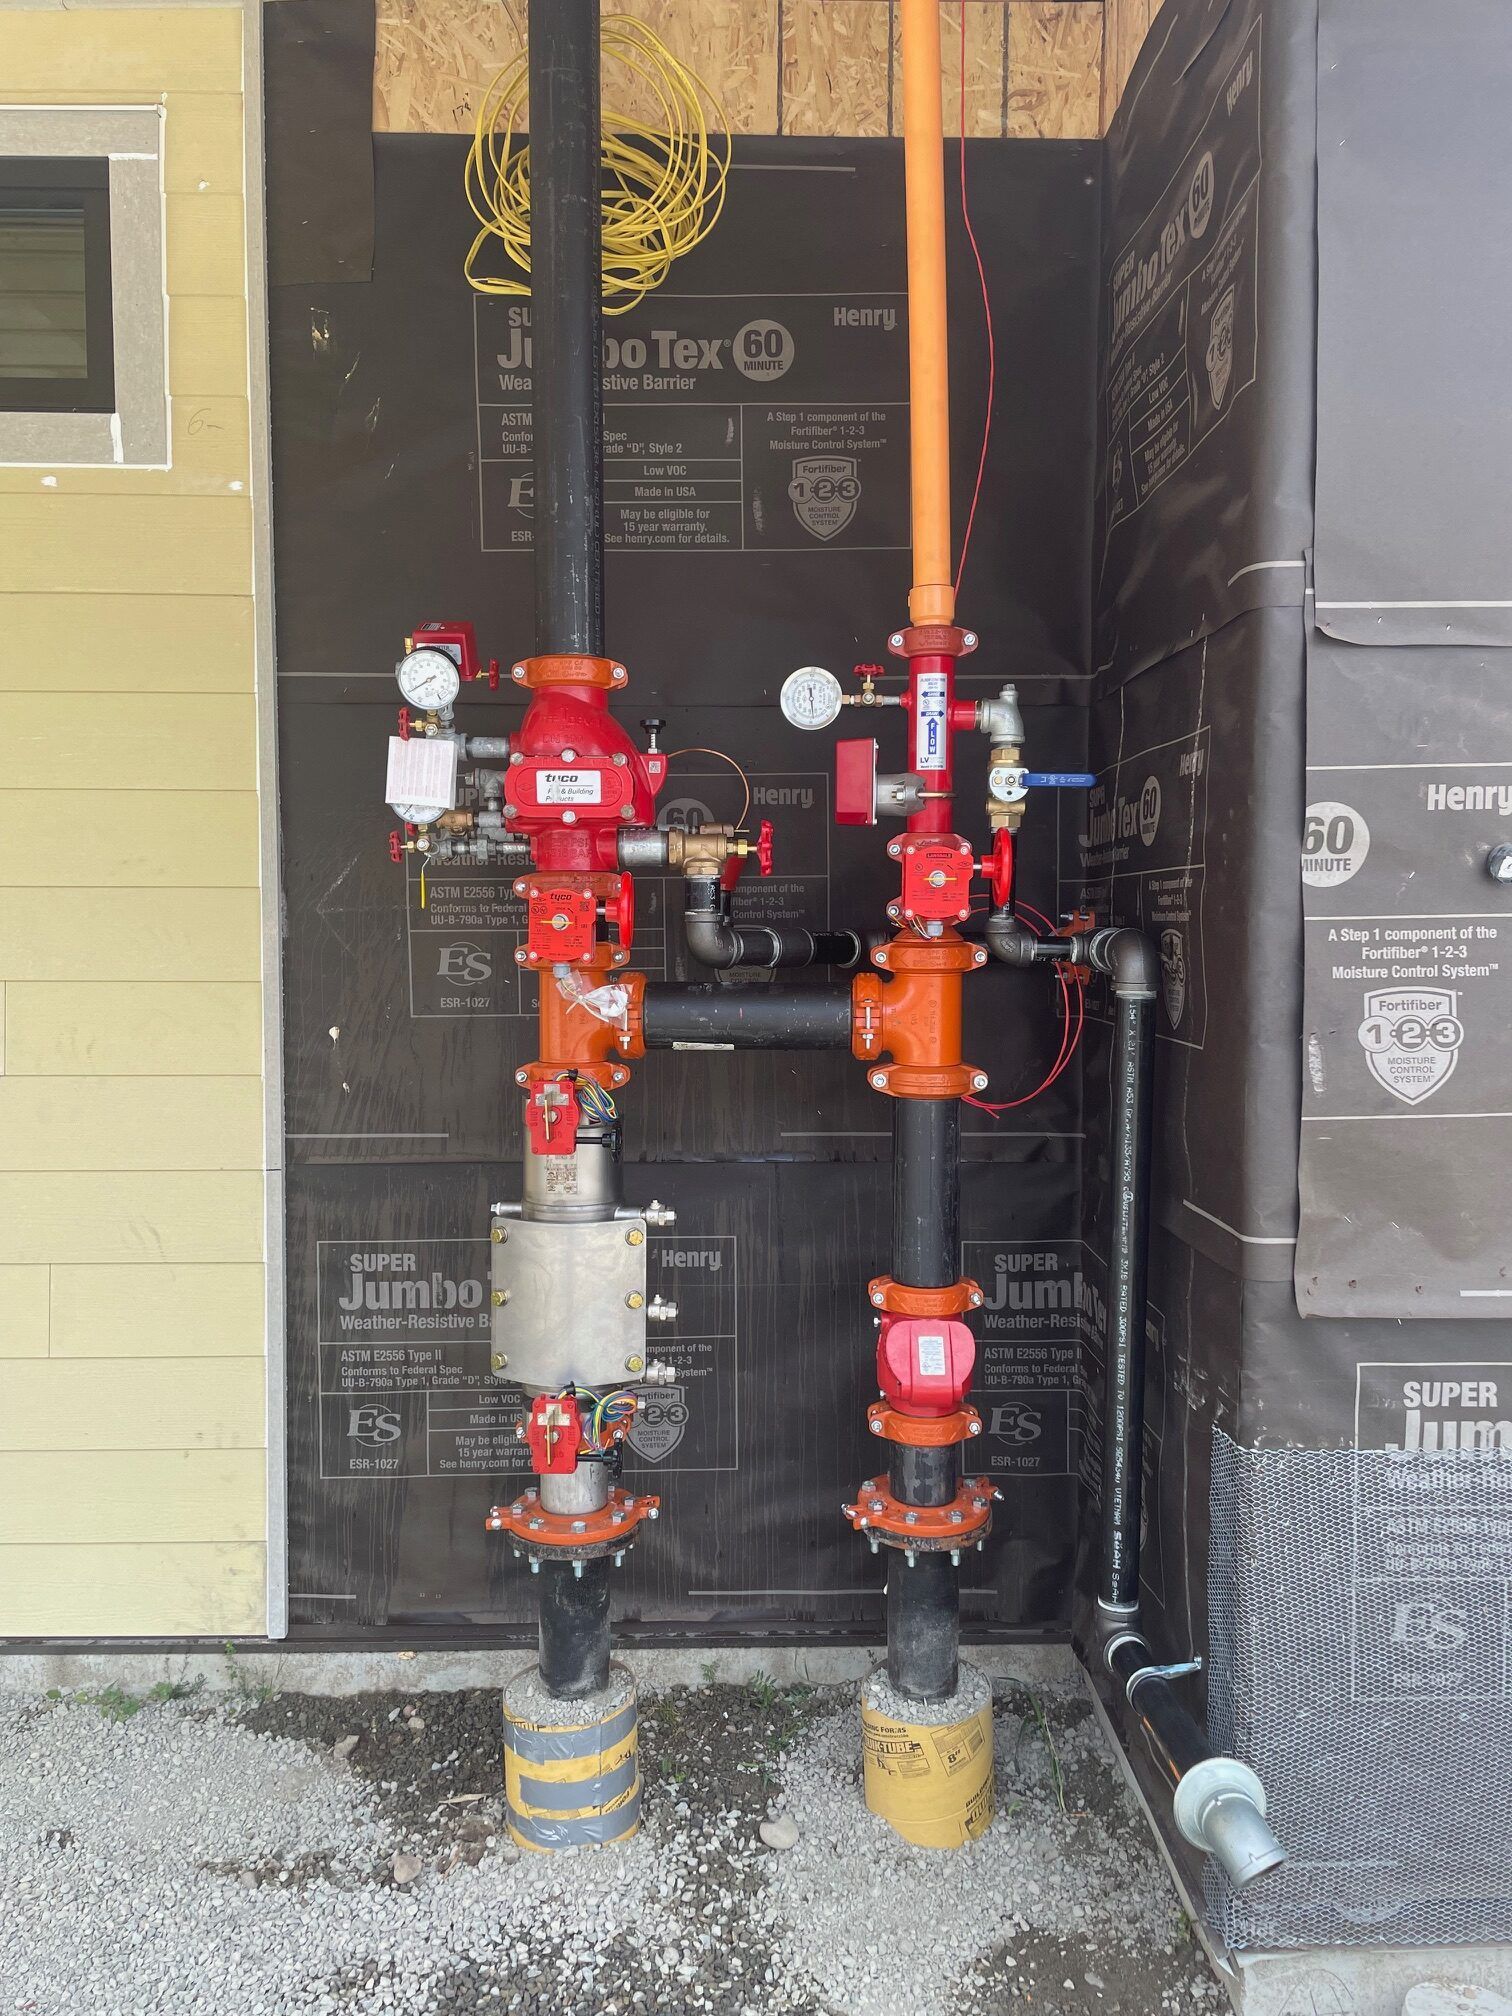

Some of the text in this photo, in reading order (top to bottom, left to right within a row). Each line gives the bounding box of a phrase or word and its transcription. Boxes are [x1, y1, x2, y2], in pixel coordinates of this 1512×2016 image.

[833, 307, 896, 330] Henry
[743, 329, 783, 358] 60
[744, 360, 783, 371] MINUTE
[643, 374, 695, 390] Barrier
[502, 412, 532, 426] ASTM
[767, 412, 886, 423] A Step 1 component of the
[603, 430, 627, 442] Spec
[840, 426, 864, 435] 1-2-3
[649, 442, 682, 455] Style 2
[770, 440, 844, 450] Moisture Control
[644, 465, 687, 476] Low VOC
[803, 465, 846, 474] Fortifiber
[634, 487, 696, 496] Made in USA
[794, 482, 855, 497] 1 2 3
[620, 509, 710, 521] May be eligible for
[624, 522, 707, 534] 15 year warranty.
[604, 533, 730, 545] See henry.com for details.
[753, 786, 813, 808] Henry
[1427, 784, 1512, 816] Henry
[1142, 786, 1157, 821] 60
[1303, 816, 1354, 855] 60
[430, 887, 495, 898] ASTM E2556
[779, 884, 804, 892] of the
[550, 893, 572, 901] tyco
[760, 897, 784, 905] 1-2-3
[430, 903, 527, 913] Conforms to Federal
[733, 910, 764, 918] Control
[430, 915, 482, 925] UU-B-790a
[485, 915, 508, 925] Type
[1328, 926, 1497, 944] A Step 1 component of the
[1432, 945, 1467, 959] 1-2-3
[437, 947, 491, 980] ES
[1332, 965, 1438, 979] Moisture Control
[440, 997, 490, 1008] ESR-1027
[1379, 1000, 1442, 1011] Fortifiber
[1367, 1022, 1456, 1044] 1 2 3
[1388, 1057, 1436, 1065] MOISTURE
[1126, 1062, 1135, 1083] ASTM
[1126, 1087, 1134, 1104] A53
[350, 1253, 416, 1272] SUPER
[662, 1250, 723, 1271] Henry
[994, 1253, 1058, 1272] SUPER
[339, 1272, 483, 1311] Jumbo
[1119, 1284, 1128, 1312] RATED
[340, 1313, 474, 1330] Weather-Resistive
[1118, 1316, 1127, 1348] 300PSI
[687, 1344, 697, 1352] of
[341, 1350, 441, 1363] ASTM E2556 Type II
[669, 1356, 692, 1364] 1-2-3
[984, 1348, 1074, 1361] ASTM E2556 Type
[341, 1365, 463, 1376] Conforms to Federal Spec
[984, 1364, 1078, 1373] Conforms to Federal
[1117, 1353, 1126, 1385] TESTED
[341, 1378, 393, 1387] UU-B-790a
[396, 1377, 418, 1388] Type
[432, 1376, 459, 1385] Grade
[984, 1376, 1034, 1384] UU-B-790a
[1037, 1375, 1059, 1385] Type
[479, 1394, 521, 1404] Low VOC
[1117, 1390, 1124, 1400] TO
[1403, 1382, 1498, 1408] SUPER
[470, 1413, 507, 1424] Made in
[648, 1406, 684, 1422] 2 3
[347, 1409, 401, 1442] ES
[988, 1407, 1042, 1441] ES
[1116, 1404, 1124, 1442] 1200PSI
[456, 1435, 492, 1447] May be
[458, 1449, 493, 1458] 15 year
[349, 1459, 399, 1469] ESR-1027
[440, 1458, 525, 1469] See henry.com for
[991, 1456, 1041, 1467] ESR-1027
[1114, 1487, 1122, 1526] VIETNAM
